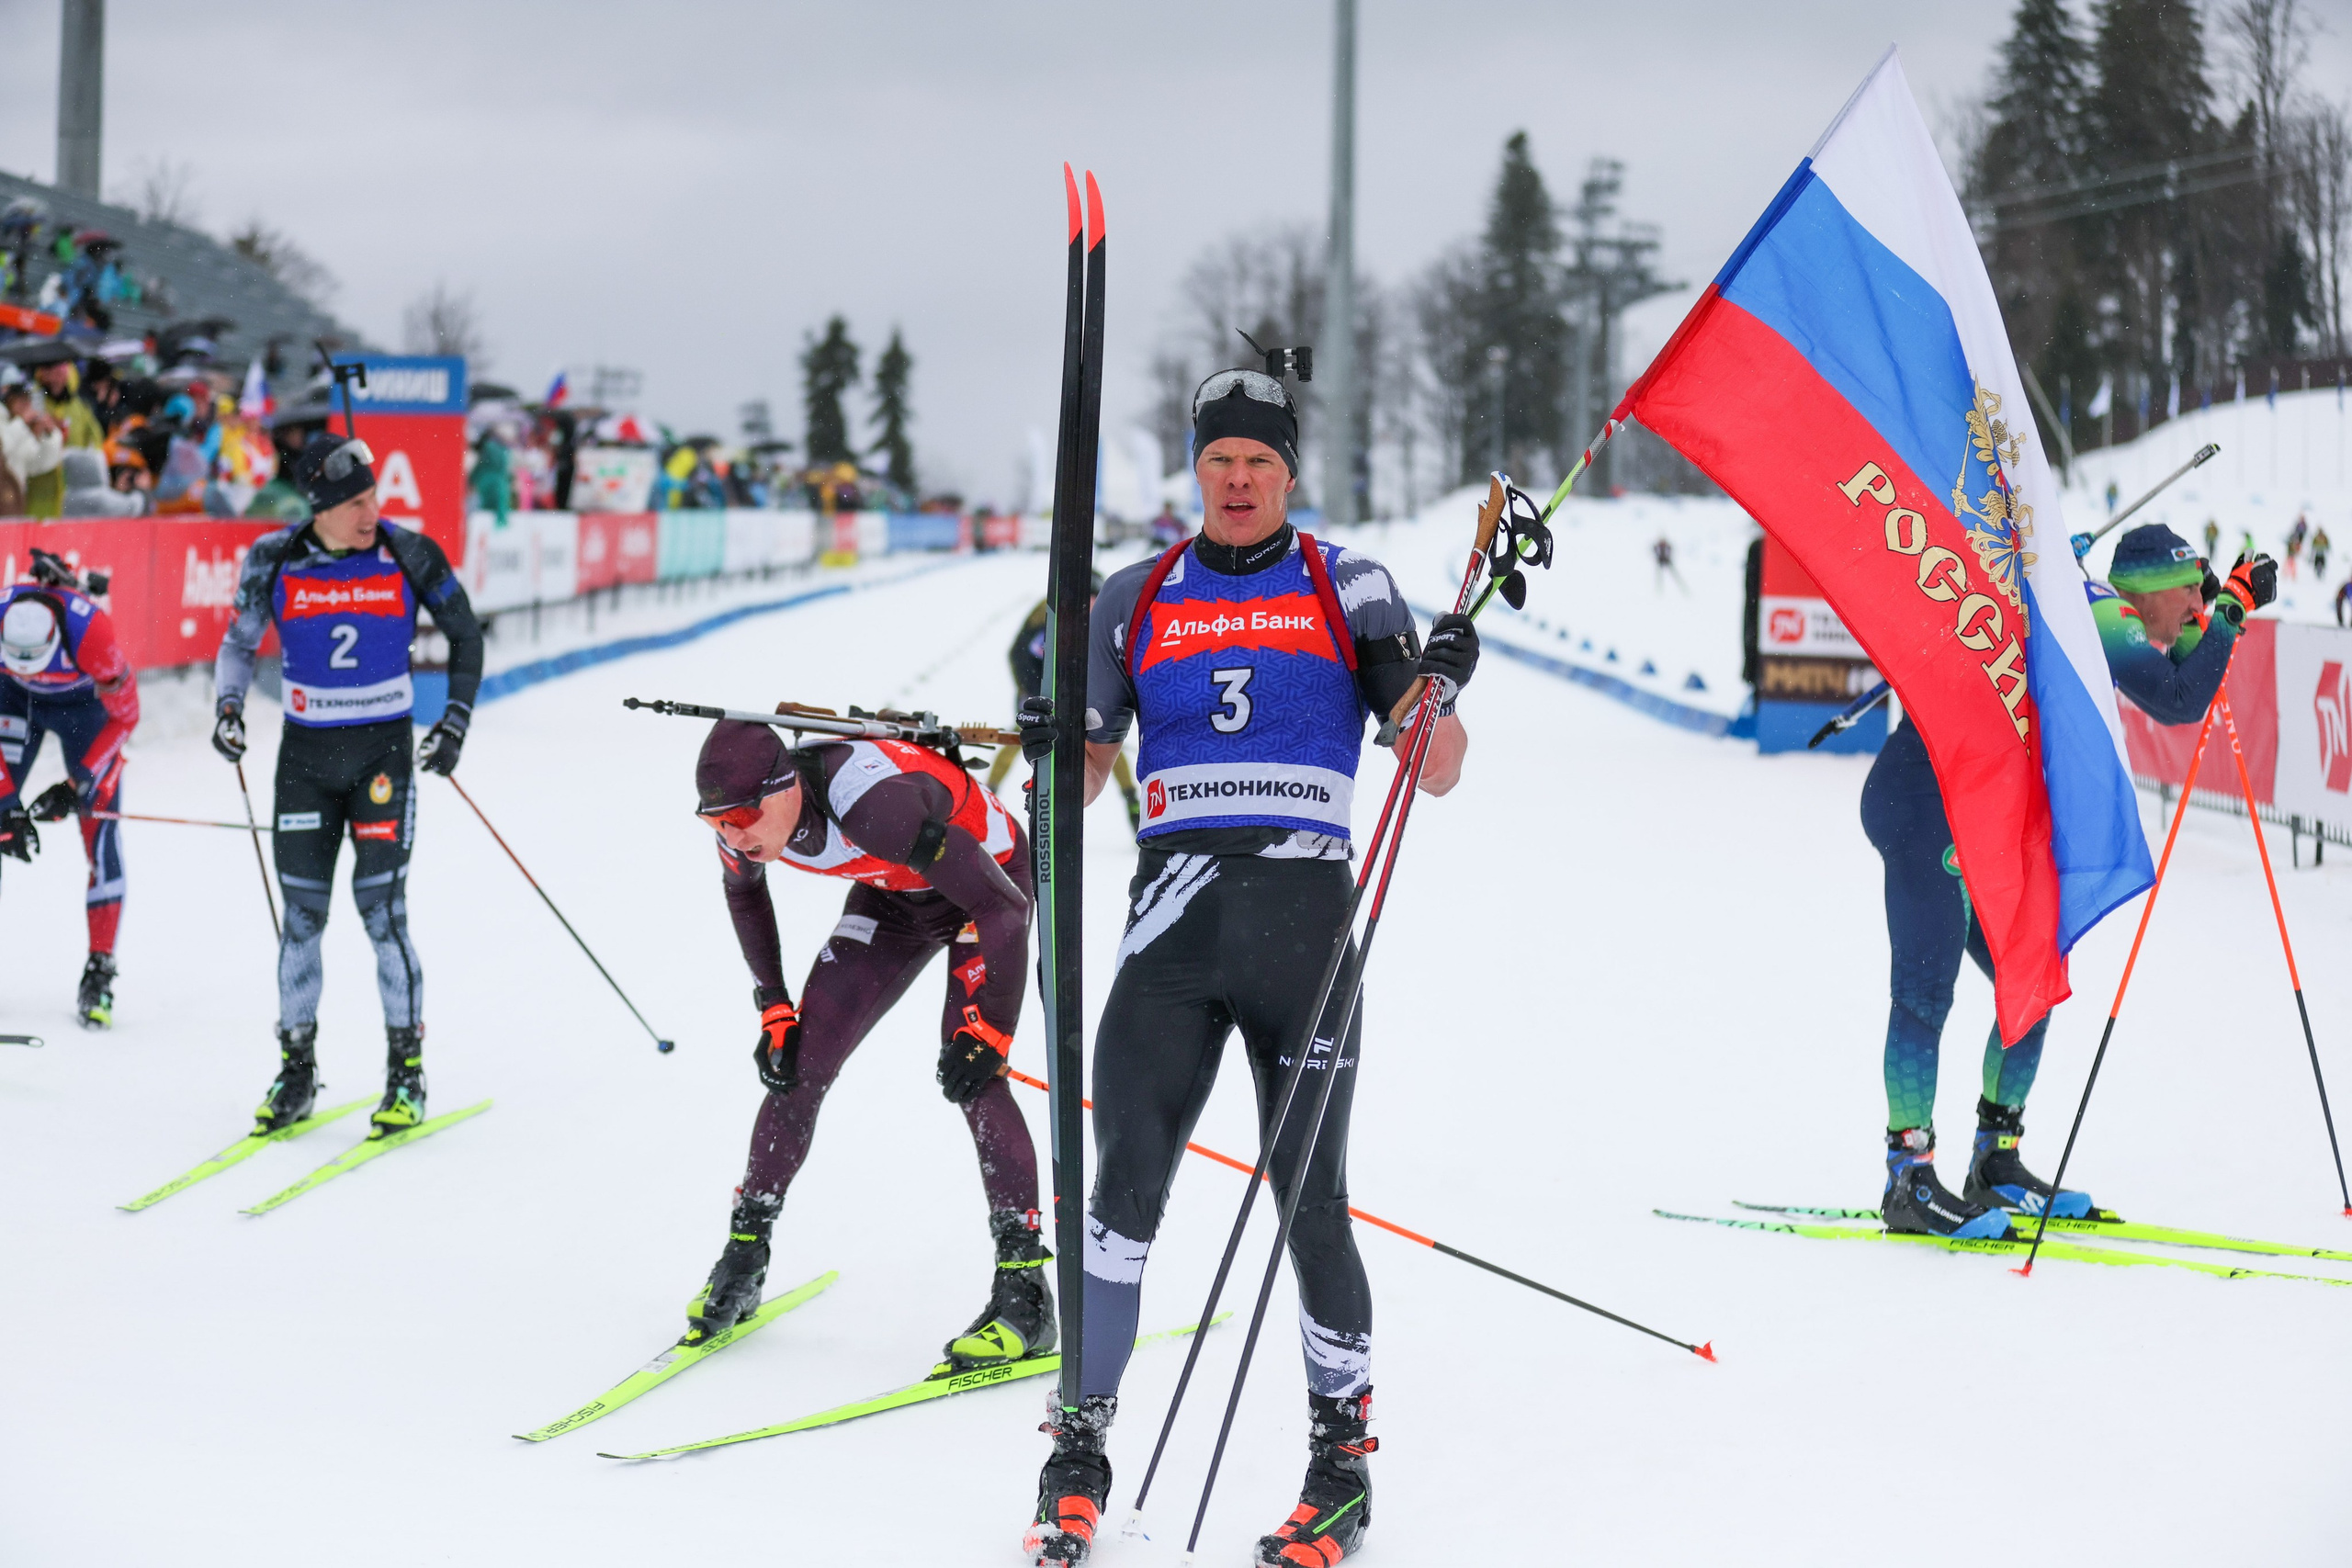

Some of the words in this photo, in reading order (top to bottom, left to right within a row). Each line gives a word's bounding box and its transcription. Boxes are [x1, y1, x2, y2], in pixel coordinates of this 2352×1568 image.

[293, 588, 351, 610] Альфа
[1836, 460, 2030, 759] РОССИ
[1161, 613, 1246, 639] Альфа
[1250, 611, 1316, 631] Банк
[330, 623, 359, 671] 2
[1209, 666, 1255, 734] 3
[1168, 780, 1331, 804] ТЕХНОНИКОЛЬ
[1038, 787, 1051, 884] ROSSIGNOL
[1279, 1055, 1355, 1070] NRSKI
[1928, 1201, 1964, 1224] SALOMON
[2031, 1219, 2098, 1231] FSCHER
[1950, 1239, 2016, 1251] FISCHER
[998, 1259, 1043, 1269] FISCHER
[949, 1366, 1012, 1392] FISCHER
[546, 1401, 606, 1434] FISCHER
